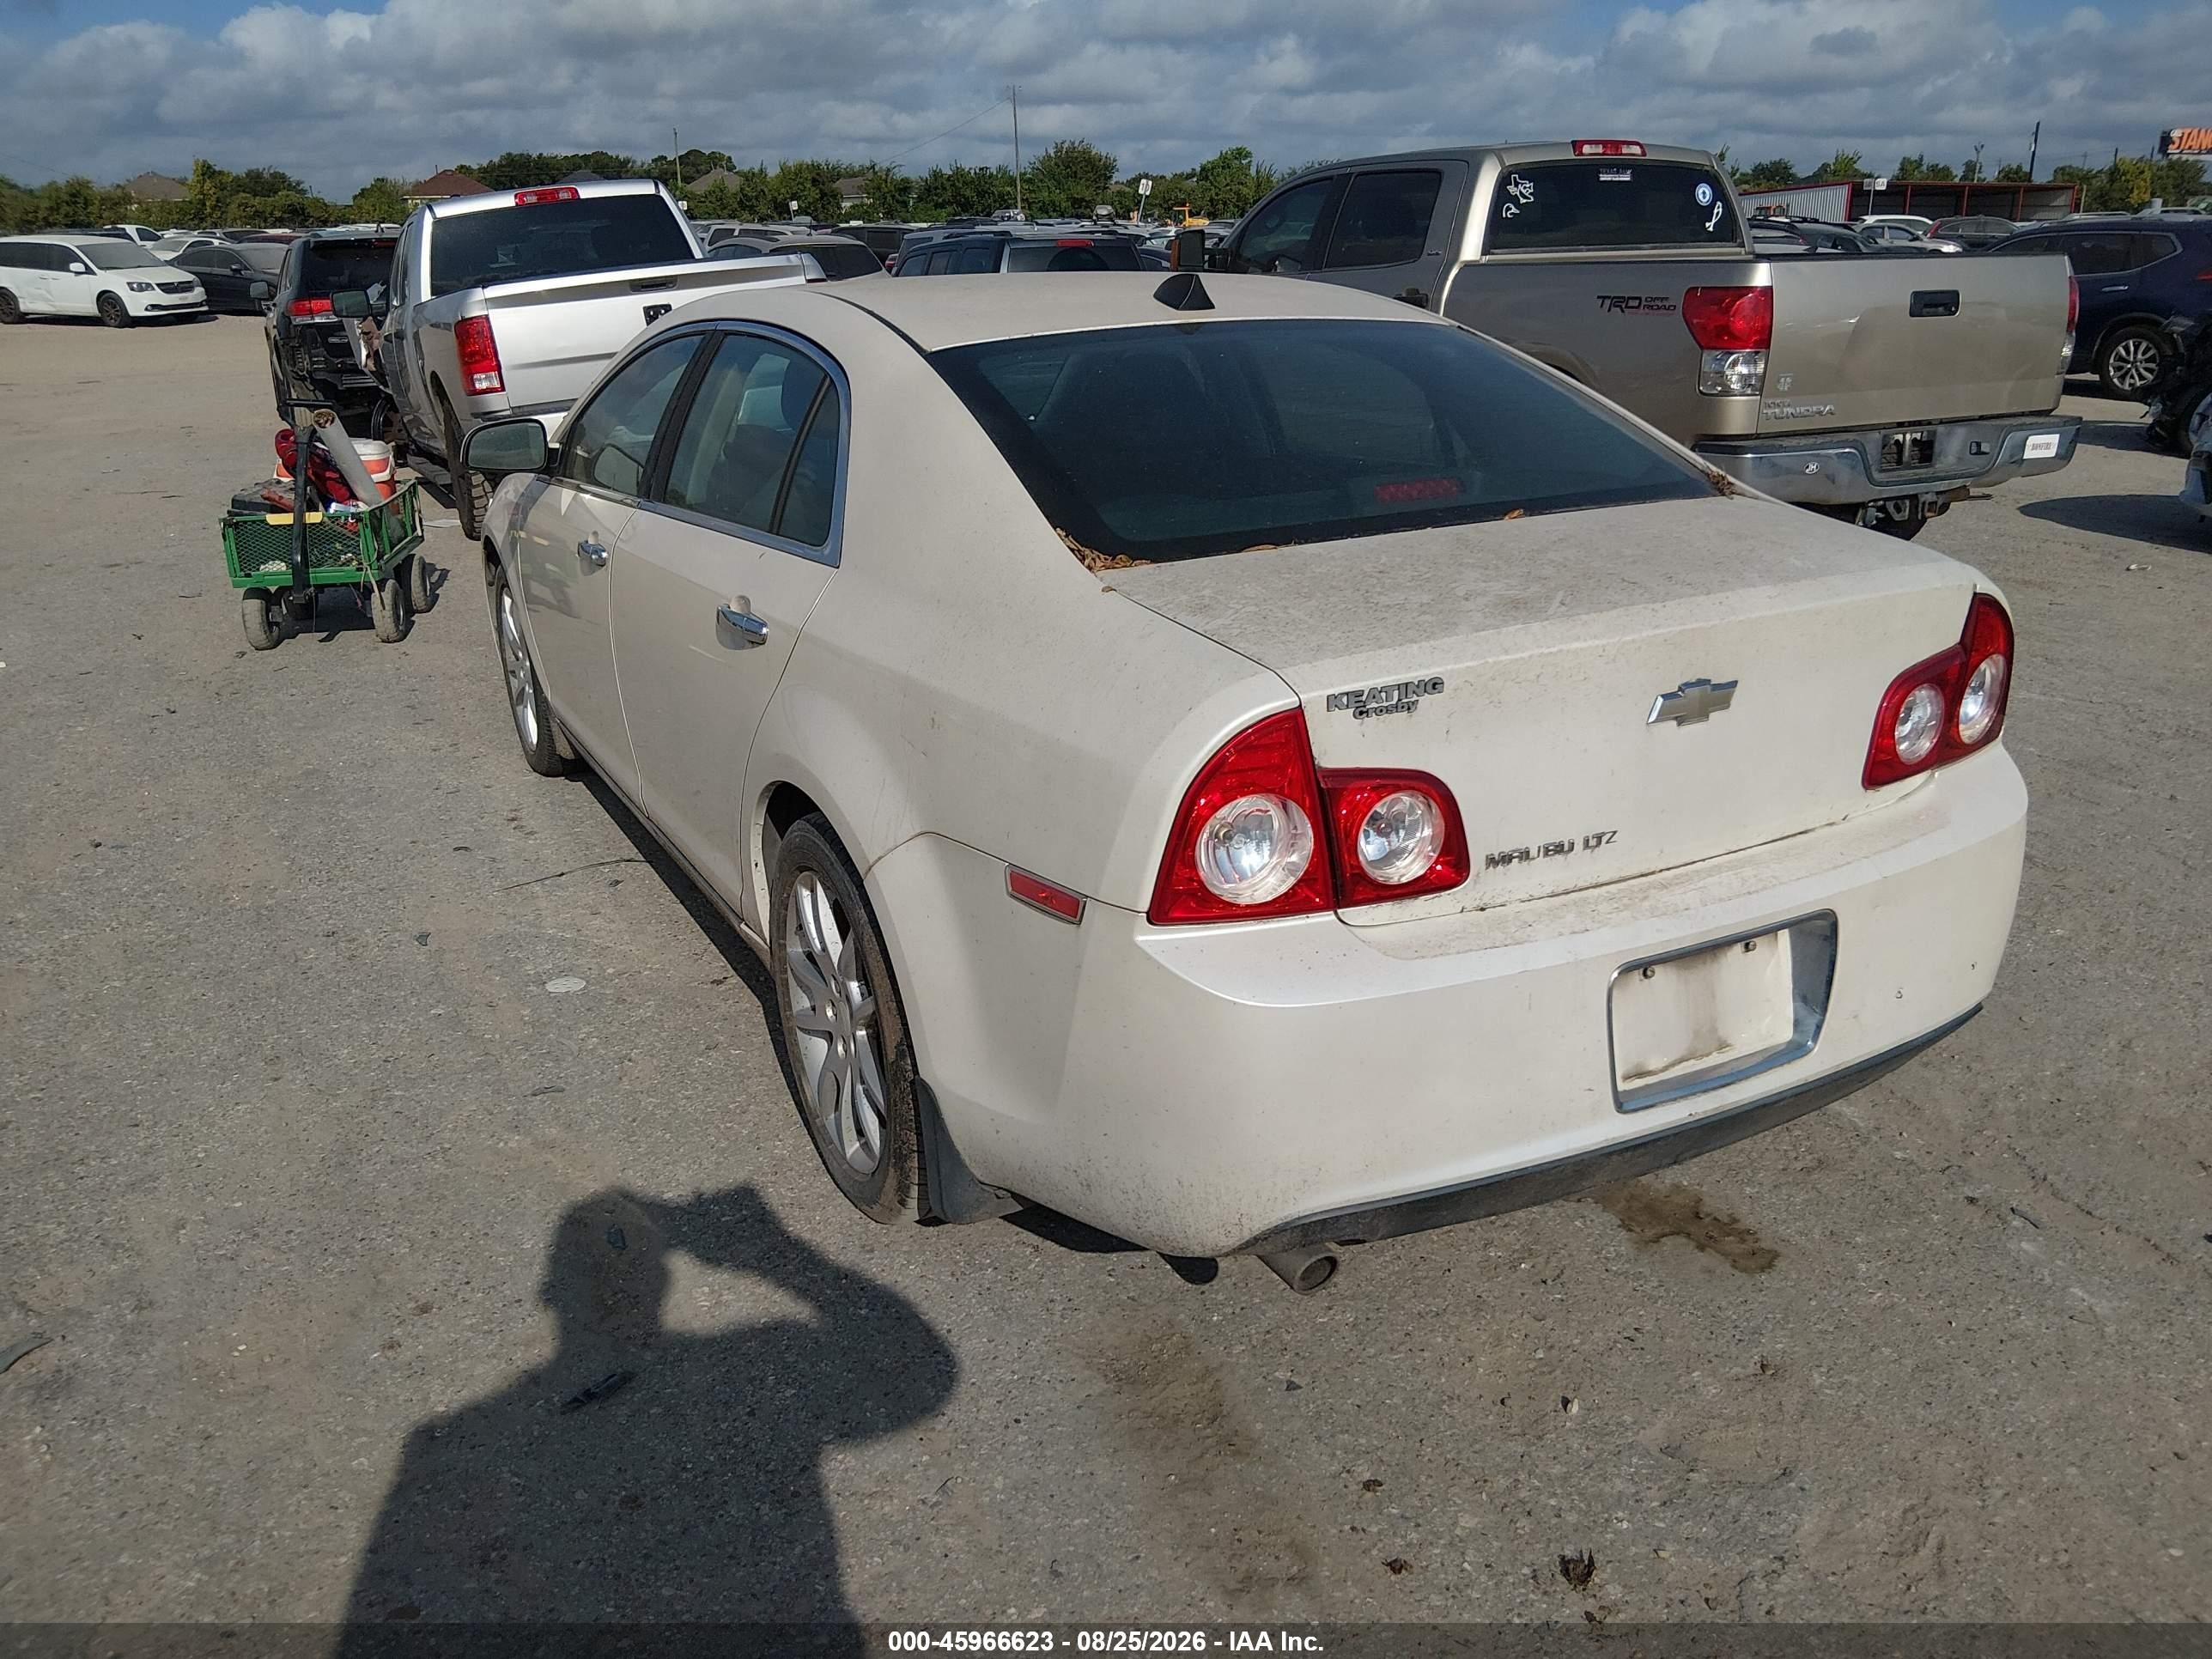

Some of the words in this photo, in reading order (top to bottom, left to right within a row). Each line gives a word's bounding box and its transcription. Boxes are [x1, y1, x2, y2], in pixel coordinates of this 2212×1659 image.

[1596, 295, 1643, 313] TRD
[1762, 404, 1835, 421] TUNDRA
[1327, 677, 1444, 712] KEATING
[1352, 699, 1419, 720] Crosby
[1485, 838, 1575, 871] MALIBU
[1583, 830, 1619, 851] LTZ
